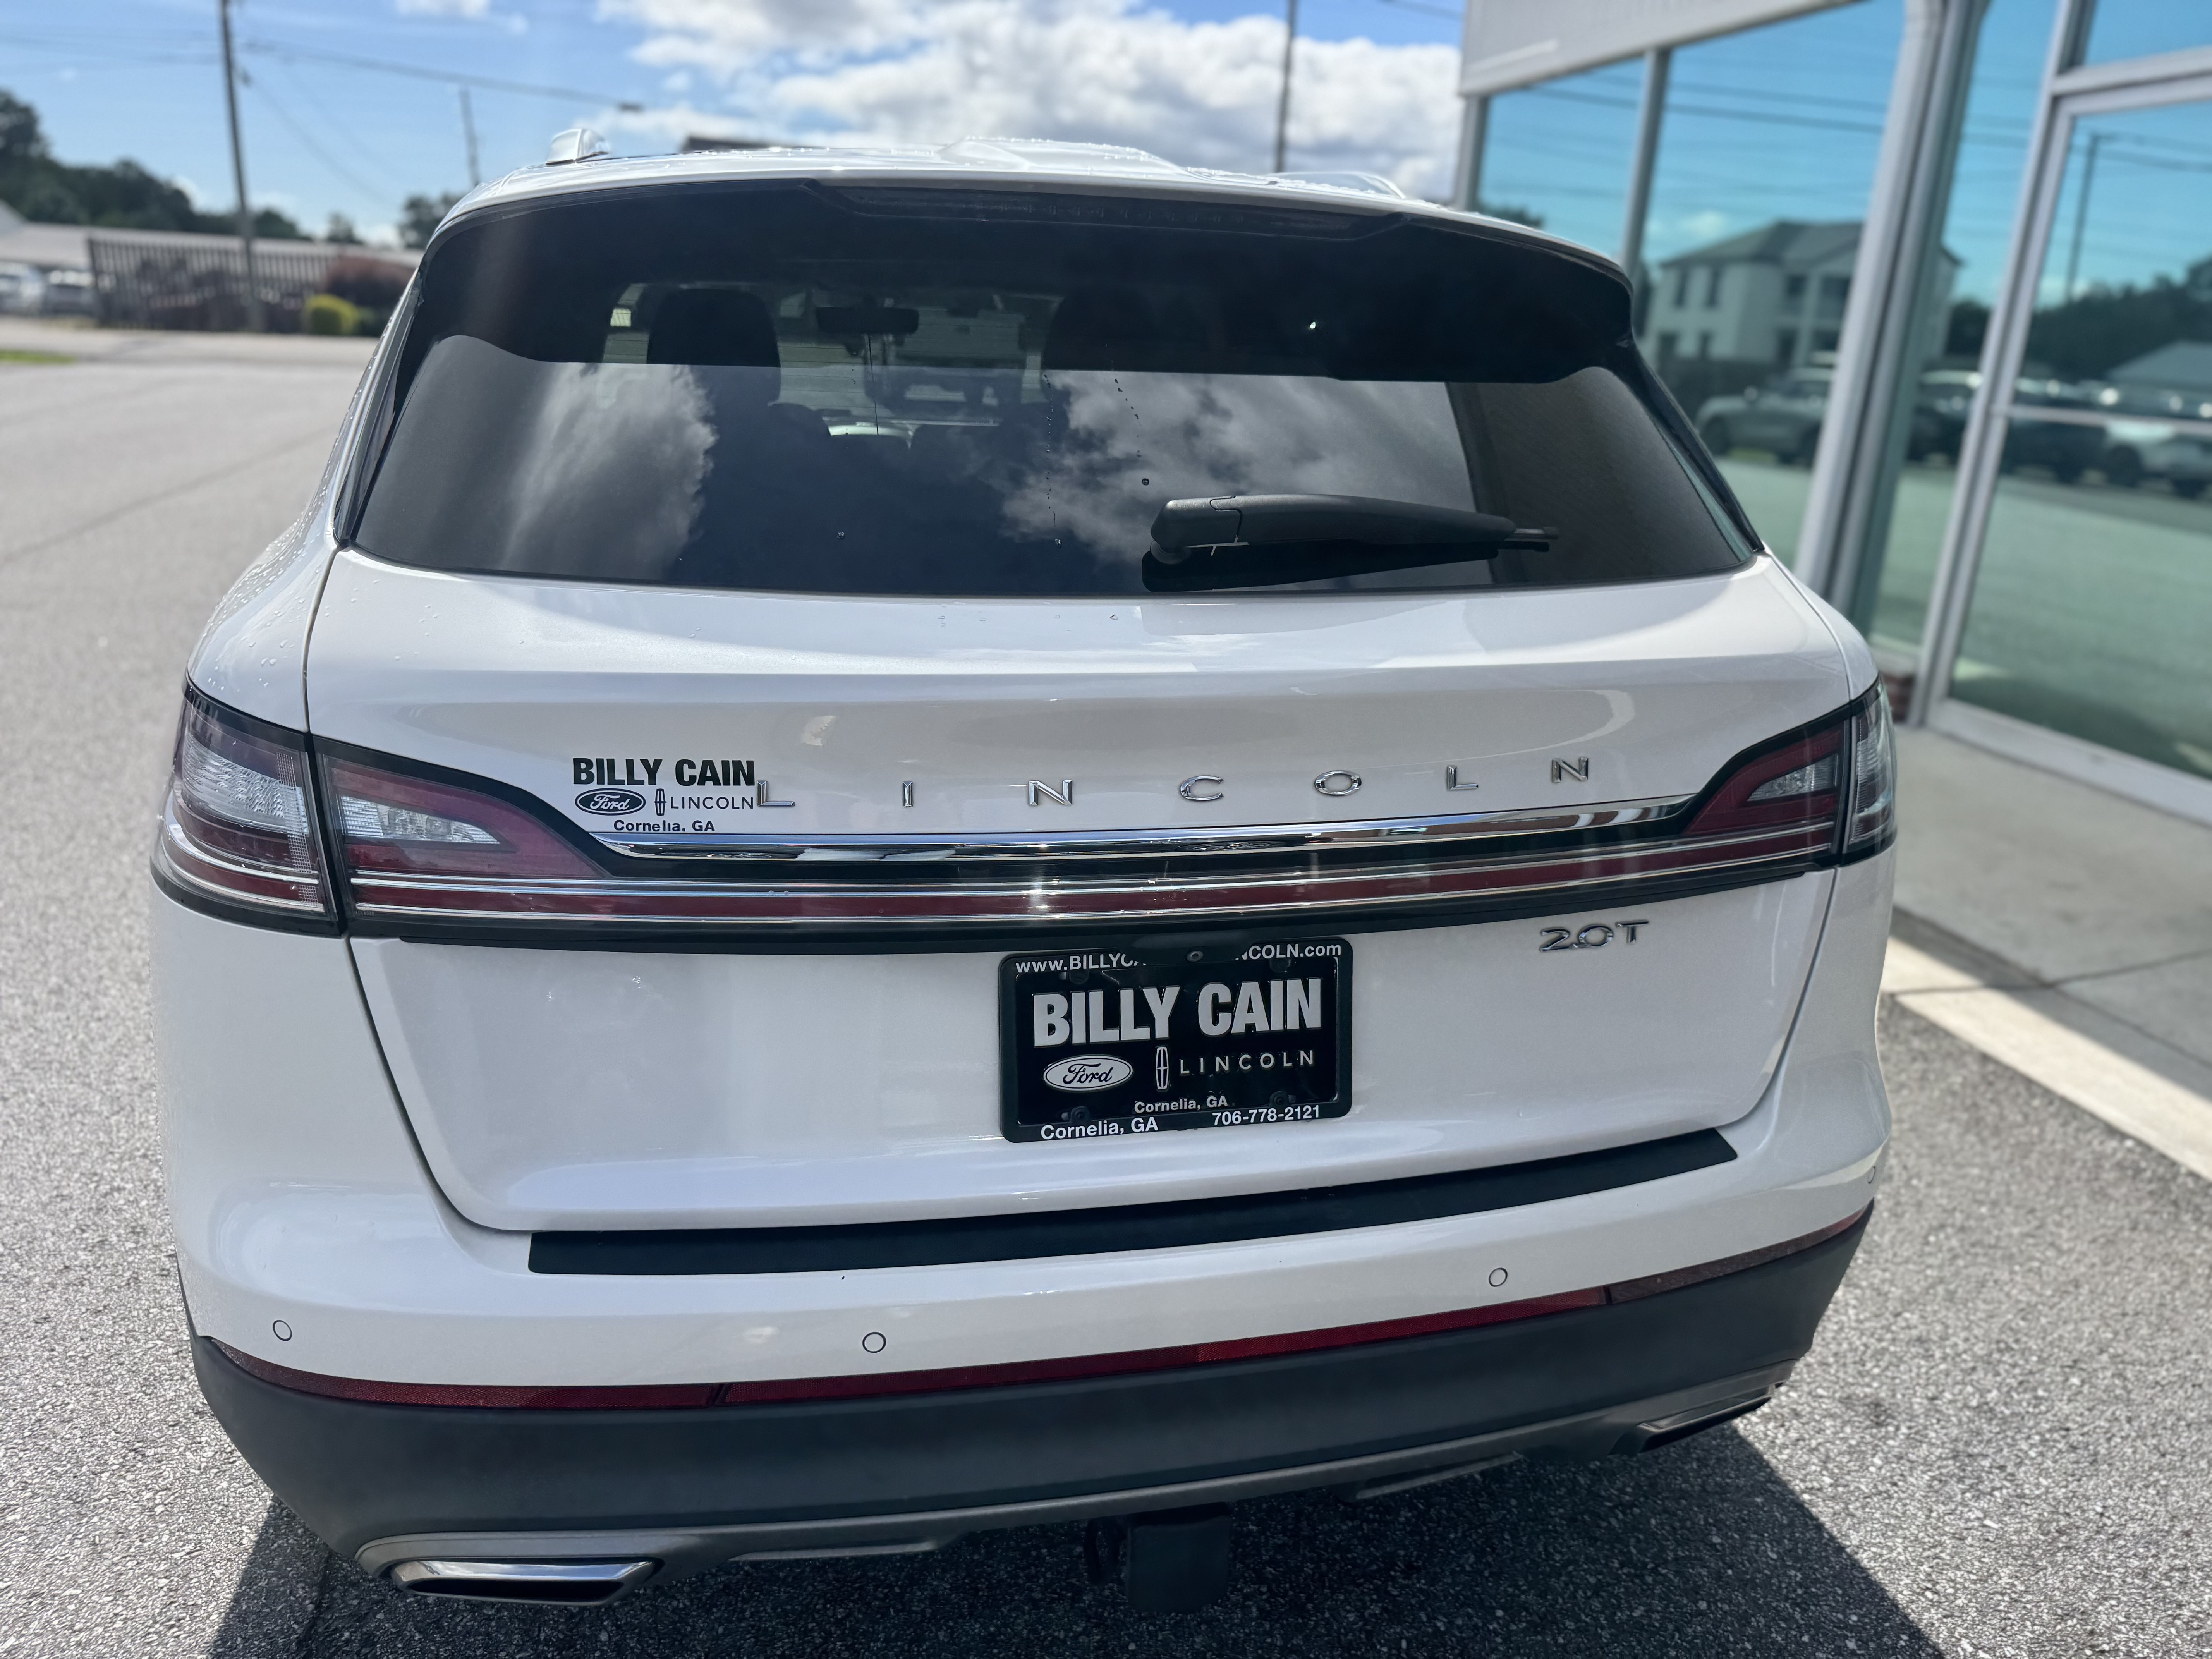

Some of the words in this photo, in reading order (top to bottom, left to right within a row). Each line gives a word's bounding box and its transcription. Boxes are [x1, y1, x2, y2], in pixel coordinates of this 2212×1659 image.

[573, 758, 663, 785] BILLY
[675, 759, 755, 786] CAIN
[757, 757, 1588, 808] LINCOLN
[590, 794, 630, 810] Ford
[671, 796, 754, 809] LINCOLN
[692, 820, 715, 831] GA
[1033, 986, 1180, 1047] BILLY
[1197, 978, 1322, 1036] CAIN
[1180, 1050, 1314, 1075] LINCOLN
[1062, 1063, 1113, 1085] Ford
[1134, 1099, 1201, 1113] Cornelia,
[1206, 1095, 1228, 1107] GA
[1212, 1105, 1319, 1126] 706-778-2121
[1041, 1121, 1124, 1140] Cornelia,
[1131, 1117, 1158, 1132] GA
